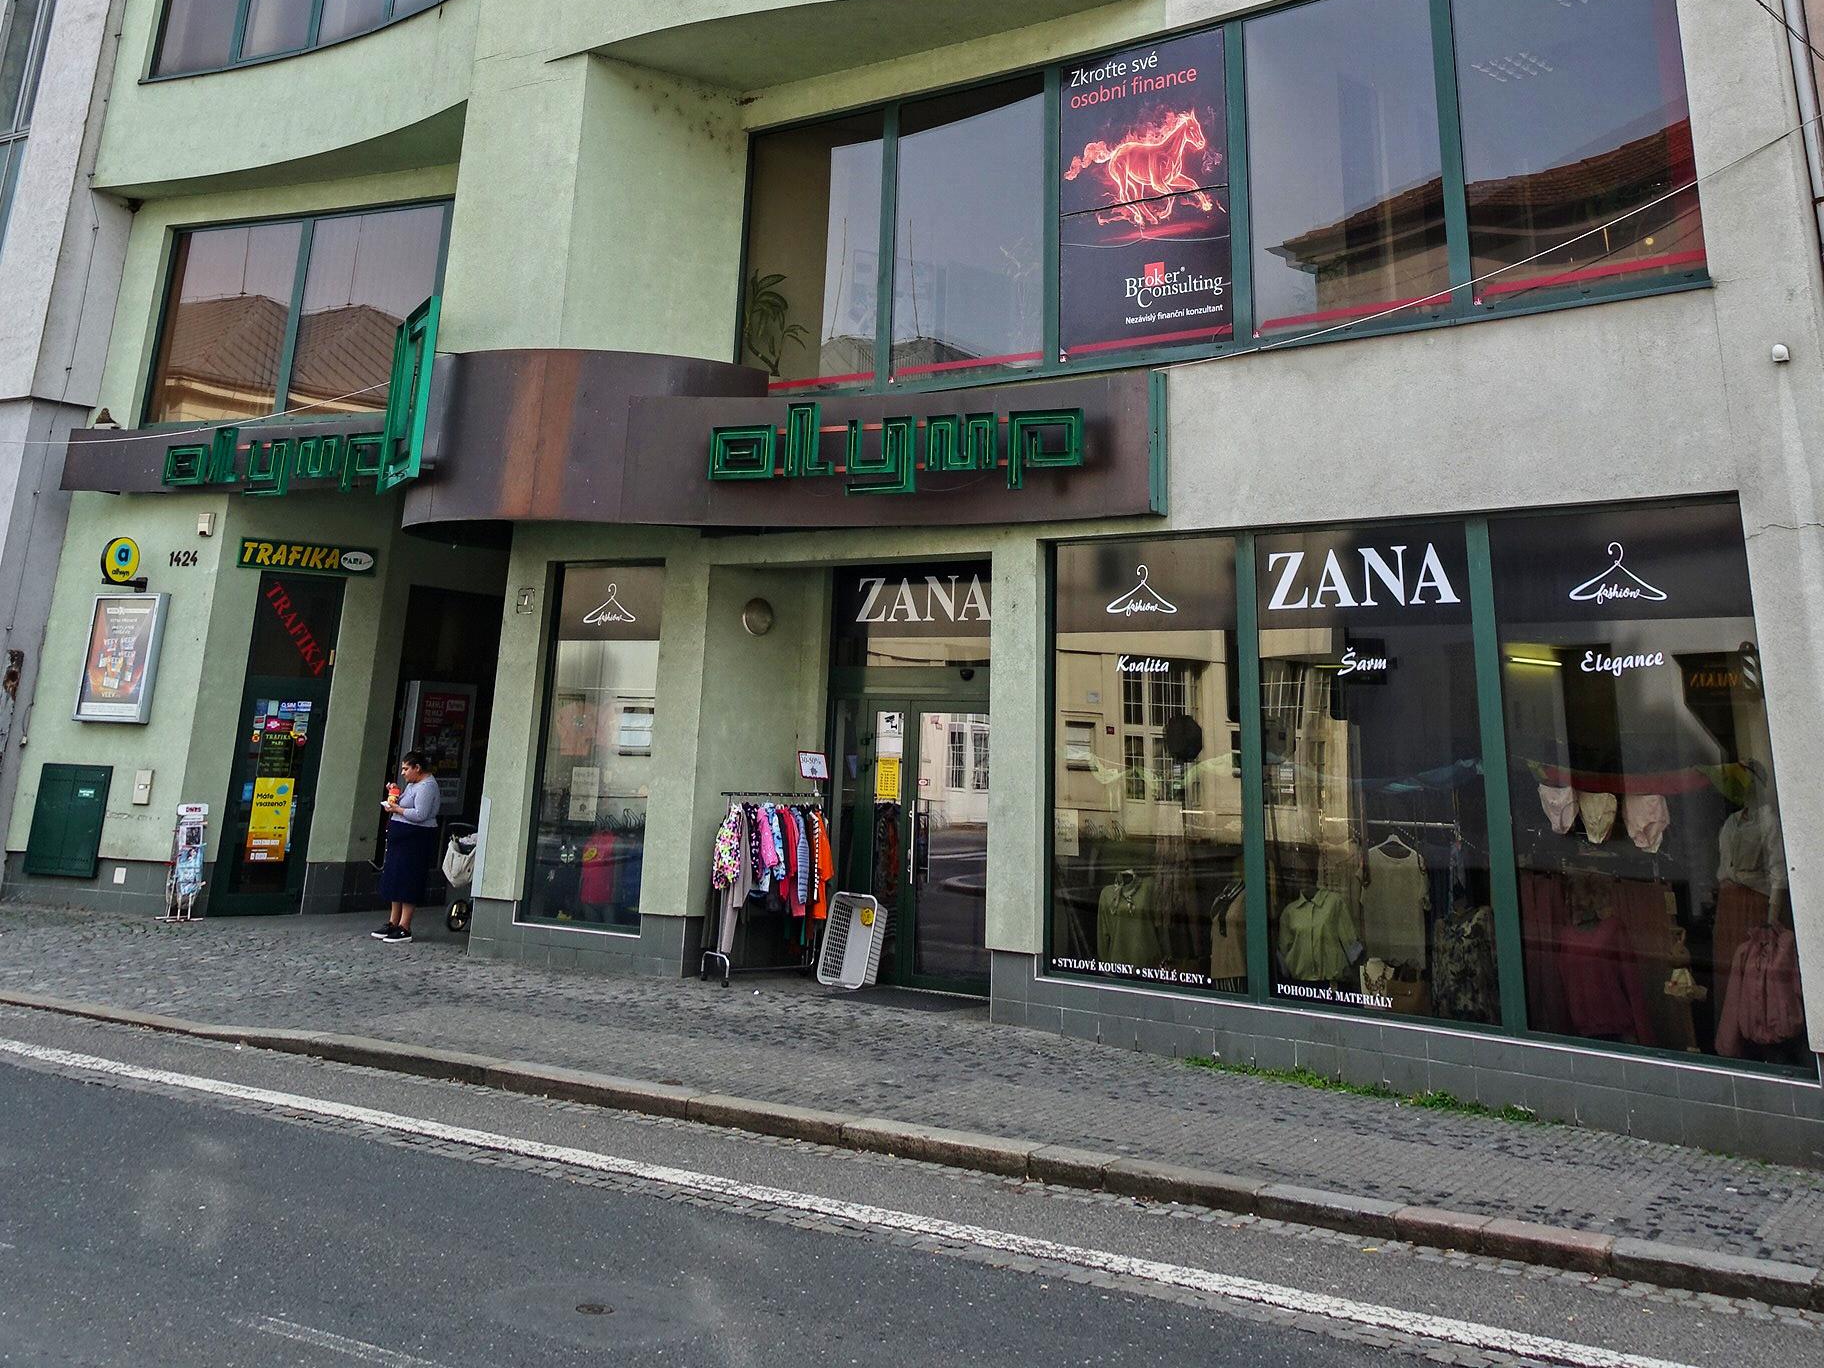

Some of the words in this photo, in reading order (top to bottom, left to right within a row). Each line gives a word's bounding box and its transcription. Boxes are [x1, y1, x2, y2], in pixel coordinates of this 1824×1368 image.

[1070, 60, 1127, 88] Zkroťte
[1131, 50, 1158, 73] své
[1070, 79, 1127, 109] osobní
[1131, 67, 1198, 95] finance
[1137, 274, 1223, 308] Consulting
[1125, 312, 1156, 324] Nezávislý
[1157, 308, 1185, 320] finanční
[1186, 304, 1224, 316] konzultant
[168, 549, 198, 568] 1424
[241, 540, 341, 570] TRAFIKA
[1267, 542, 1461, 610] ZANA
[856, 573, 992, 622] ZANA
[1597, 583, 1641, 605] fashion
[265, 581, 326, 676] TRAFIKA
[1115, 655, 1170, 673] Kvalita
[1337, 646, 1387, 676] Šarm
[1580, 650, 1665, 677] Elegance
[256, 792, 274, 800] Máte
[1057, 957, 1096, 971] STYLOVÉ
[1098, 961, 1134, 975] KOUSKY
[1179, 972, 1205, 985] CENY
[1276, 983, 1333, 1000] POHODLNÉ
[1335, 991, 1394, 1008] MATERIÁLY
